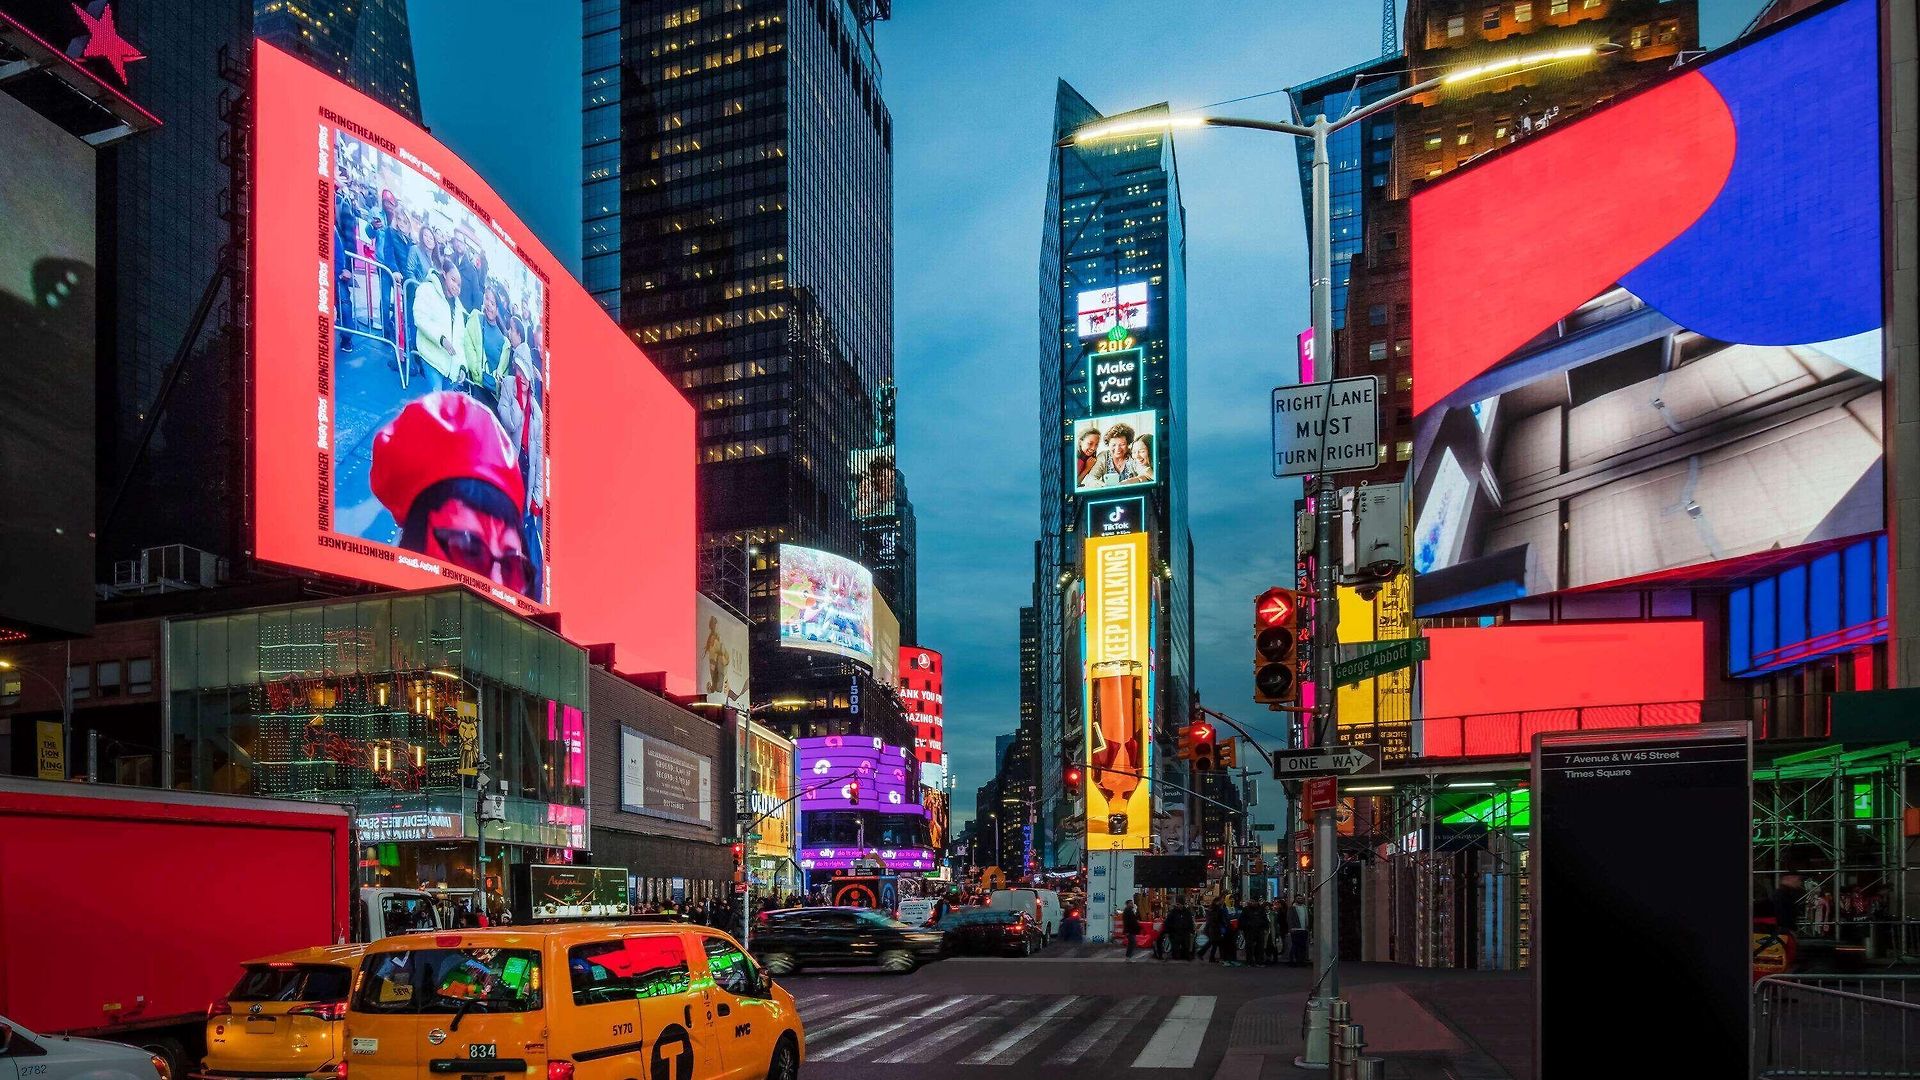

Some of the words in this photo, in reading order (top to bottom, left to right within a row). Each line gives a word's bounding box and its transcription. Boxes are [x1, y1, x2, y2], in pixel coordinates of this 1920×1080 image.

[319, 105, 397, 154] #BRINGTHEANGER
[318, 179, 329, 261] #BRINGTHEANGER
[318, 315, 330, 396] #BRINGTHEANGER
[1096, 360, 1135, 375] Make
[1099, 376, 1132, 392] your
[1101, 391, 1131, 404] day.
[1276, 395, 1323, 413] RIGHT
[1331, 389, 1373, 407] LANE
[1296, 416, 1352, 438] MUST
[1276, 448, 1317, 465] TURN
[1327, 442, 1374, 460] RIGHT
[318, 452, 330, 532] #BRINGTHEANGER
[1103, 521, 1130, 532] TikTok
[318, 535, 396, 562] #BRINGTHEANGER
[1104, 549, 1129, 623] WALKING
[1415, 640, 1428, 653] St
[1335, 659, 1370, 680] George
[1373, 643, 1409, 668] Abbott
[850, 675, 859, 714] 1500
[921, 690, 935, 701] YOU
[1288, 757, 1319, 770] ONE
[1332, 754, 1365, 768] WAY
[1565, 756, 1572, 764] 7
[1573, 755, 1610, 763] Avenue
[1612, 754, 1620, 762] &
[1622, 752, 1633, 761] W
[1634, 752, 1648, 760] 45
[1649, 751, 1680, 759] Street
[1565, 769, 1595, 778] Times
[1597, 769, 1632, 777] Square
[820, 848, 835, 859] ally
[882, 849, 896, 859] ally
[801, 859, 815, 869] ally
[612, 1022, 633, 1036] 5Y70
[735, 1023, 751, 1038] NYC
[470, 1044, 496, 1058] 834
[21, 1064, 47, 1077] 2782
